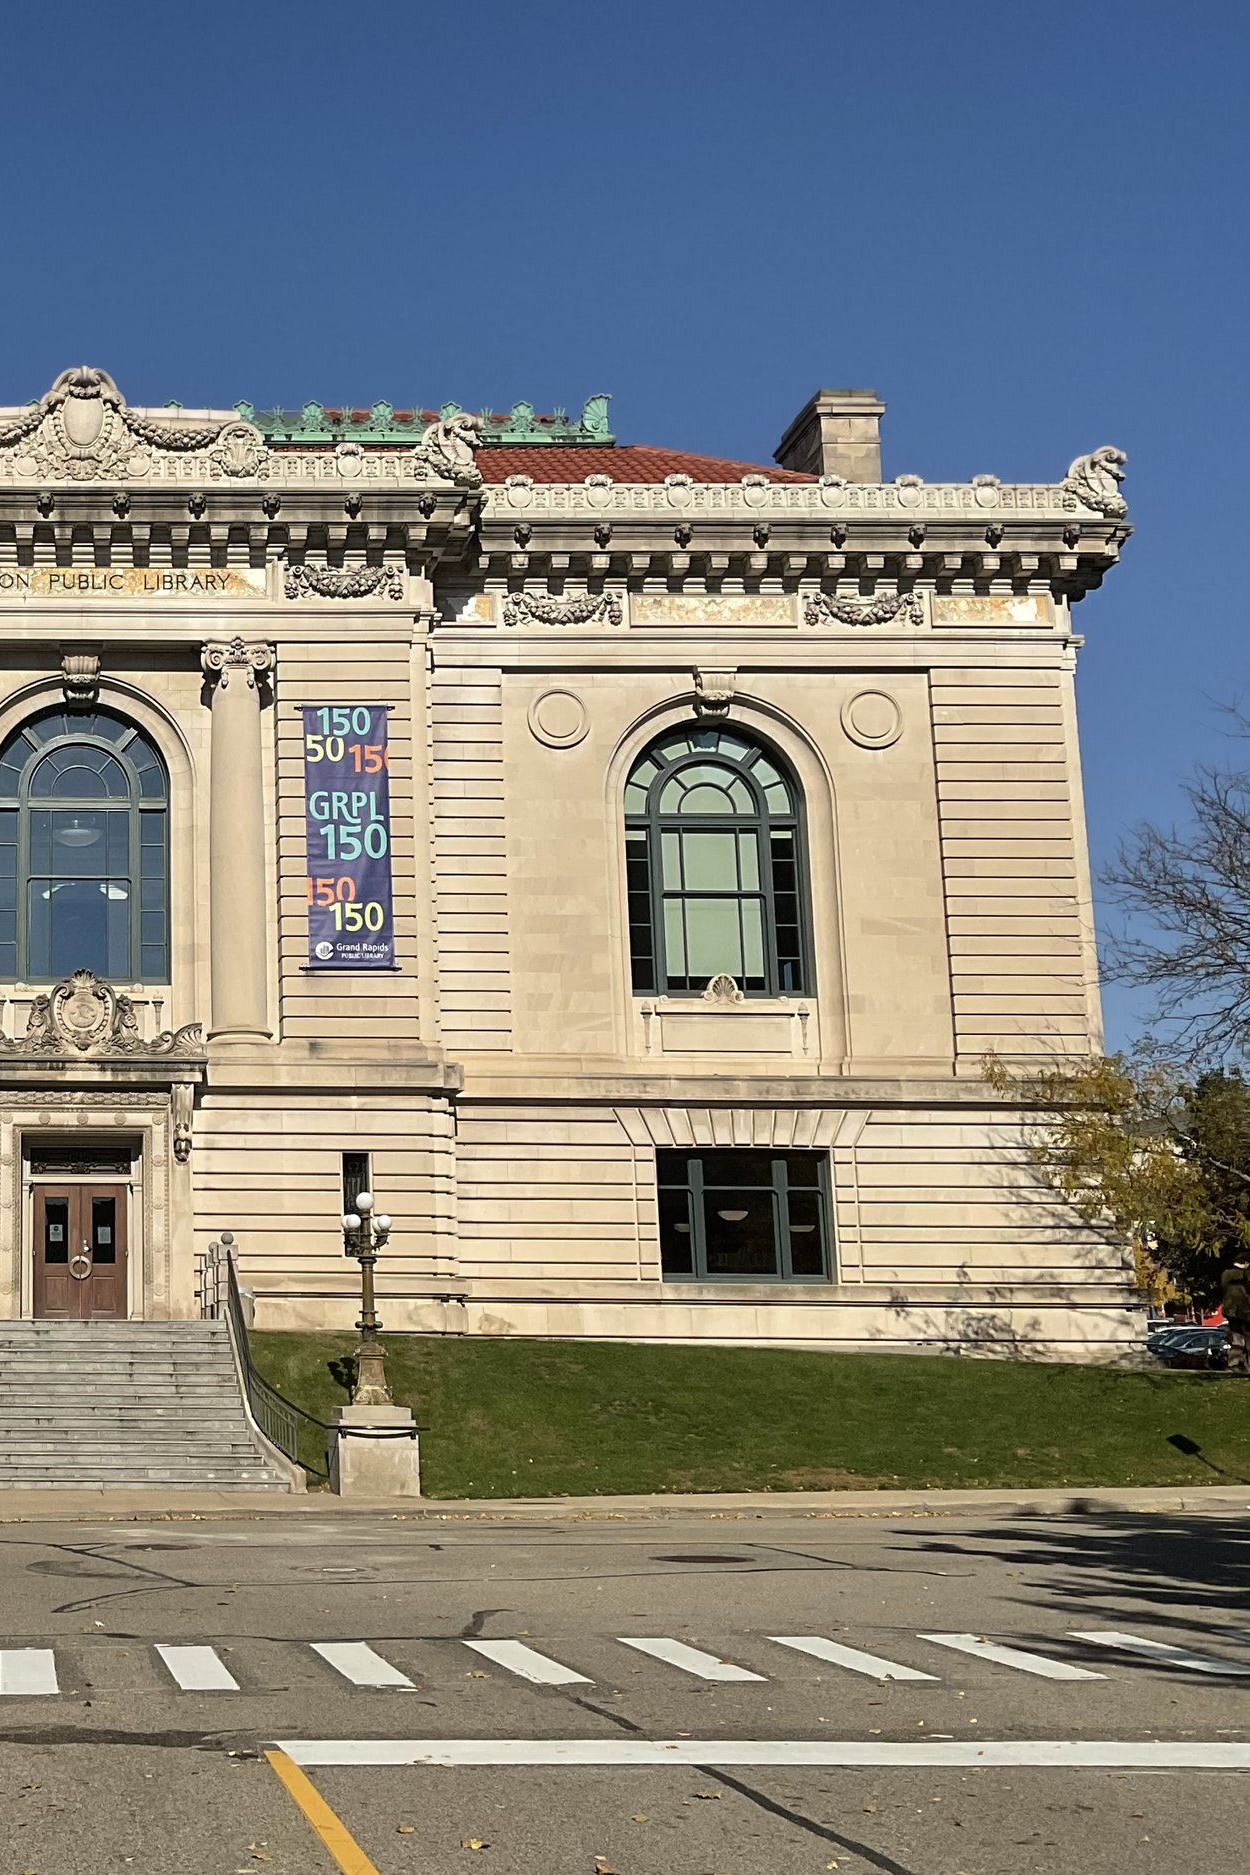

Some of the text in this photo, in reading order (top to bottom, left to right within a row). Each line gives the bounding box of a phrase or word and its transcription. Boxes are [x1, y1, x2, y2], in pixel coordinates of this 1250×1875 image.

[49, 574, 124, 590] PUBLIC
[143, 574, 231, 591] LIBRARY
[316, 707, 371, 736] 150
[348, 744, 389, 774] 15
[309, 791, 385, 823] GRPL
[319, 823, 388, 860] 150
[329, 901, 384, 932] 150
[336, 943, 389, 953] Grand Rapids
